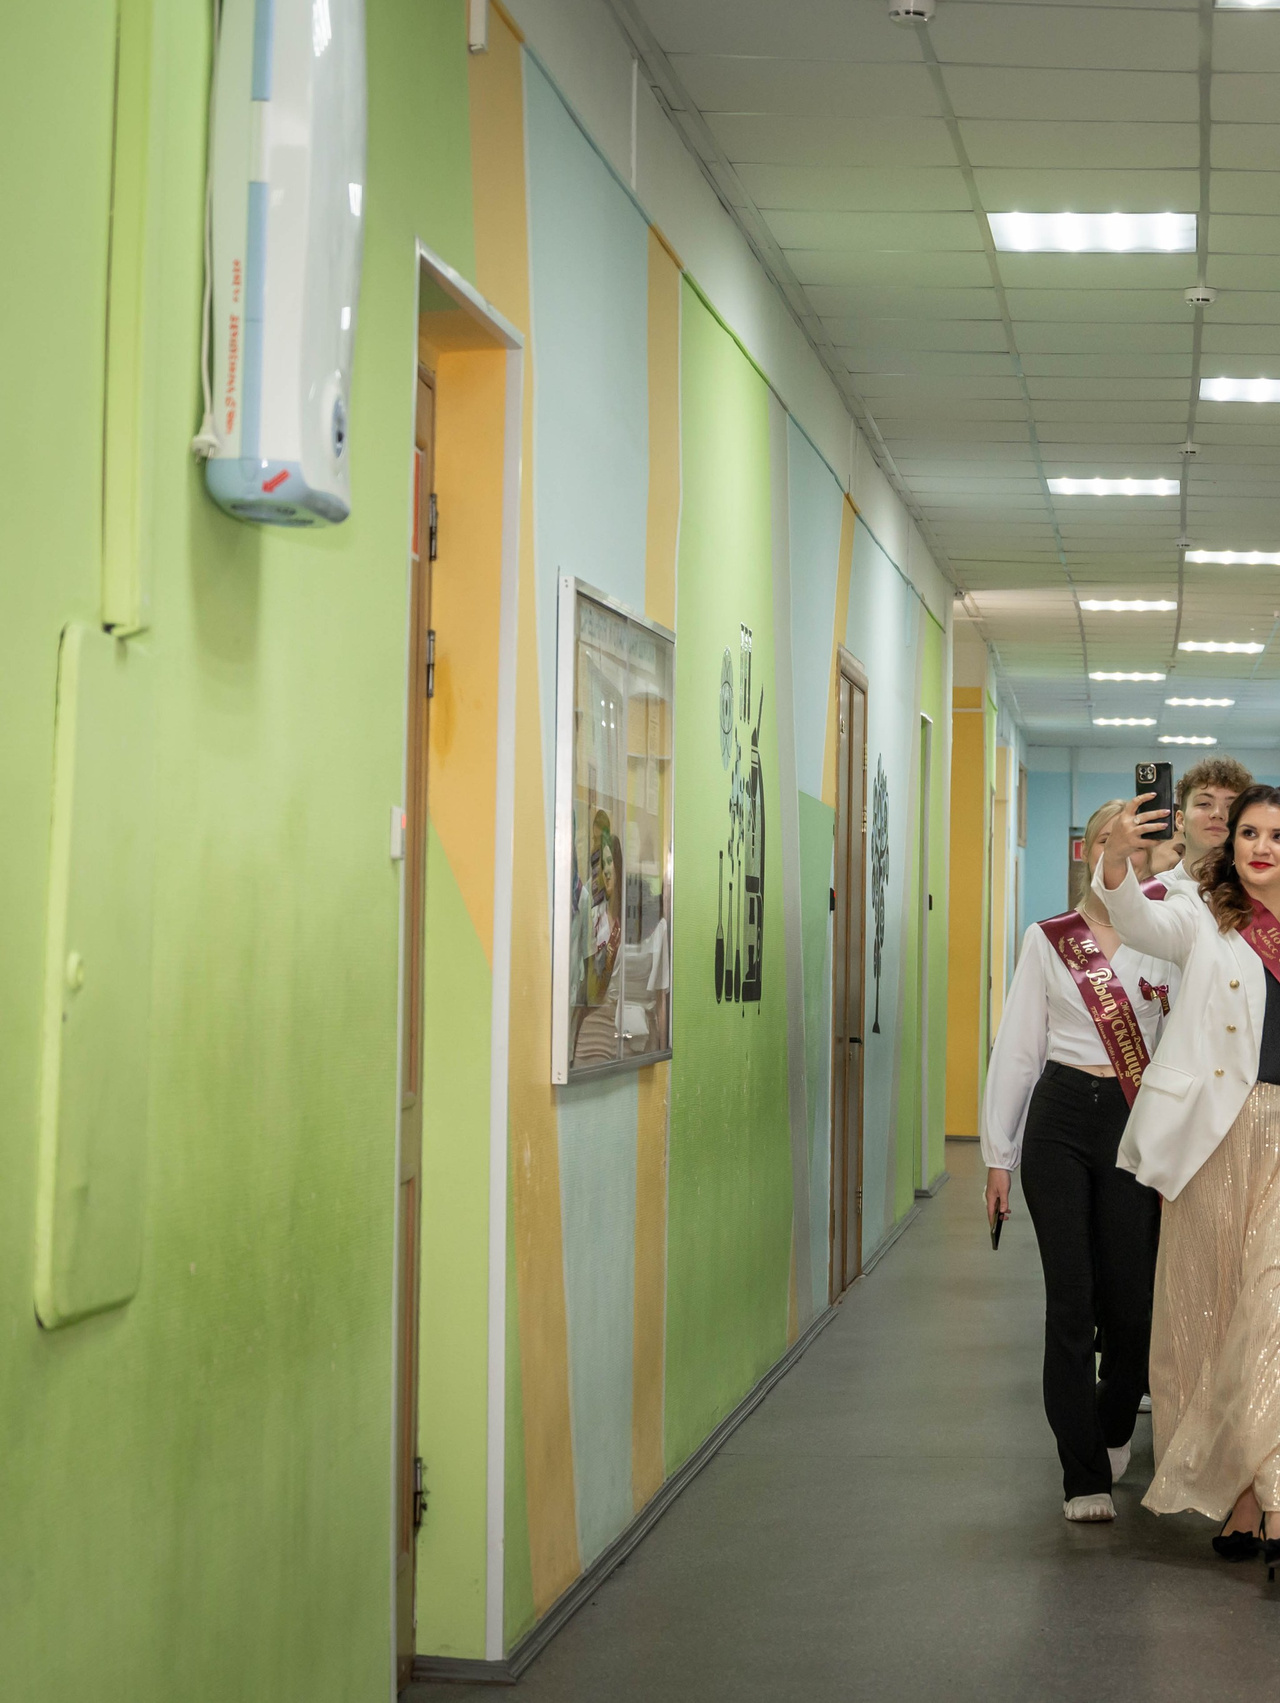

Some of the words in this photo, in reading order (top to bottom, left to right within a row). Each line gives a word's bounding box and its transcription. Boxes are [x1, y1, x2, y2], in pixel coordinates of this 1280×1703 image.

[1067, 937, 1088, 964] класс
[1081, 938, 1100, 954] 11б
[1256, 929, 1278, 955] класс
[1085, 967, 1142, 1087] Выпускница
